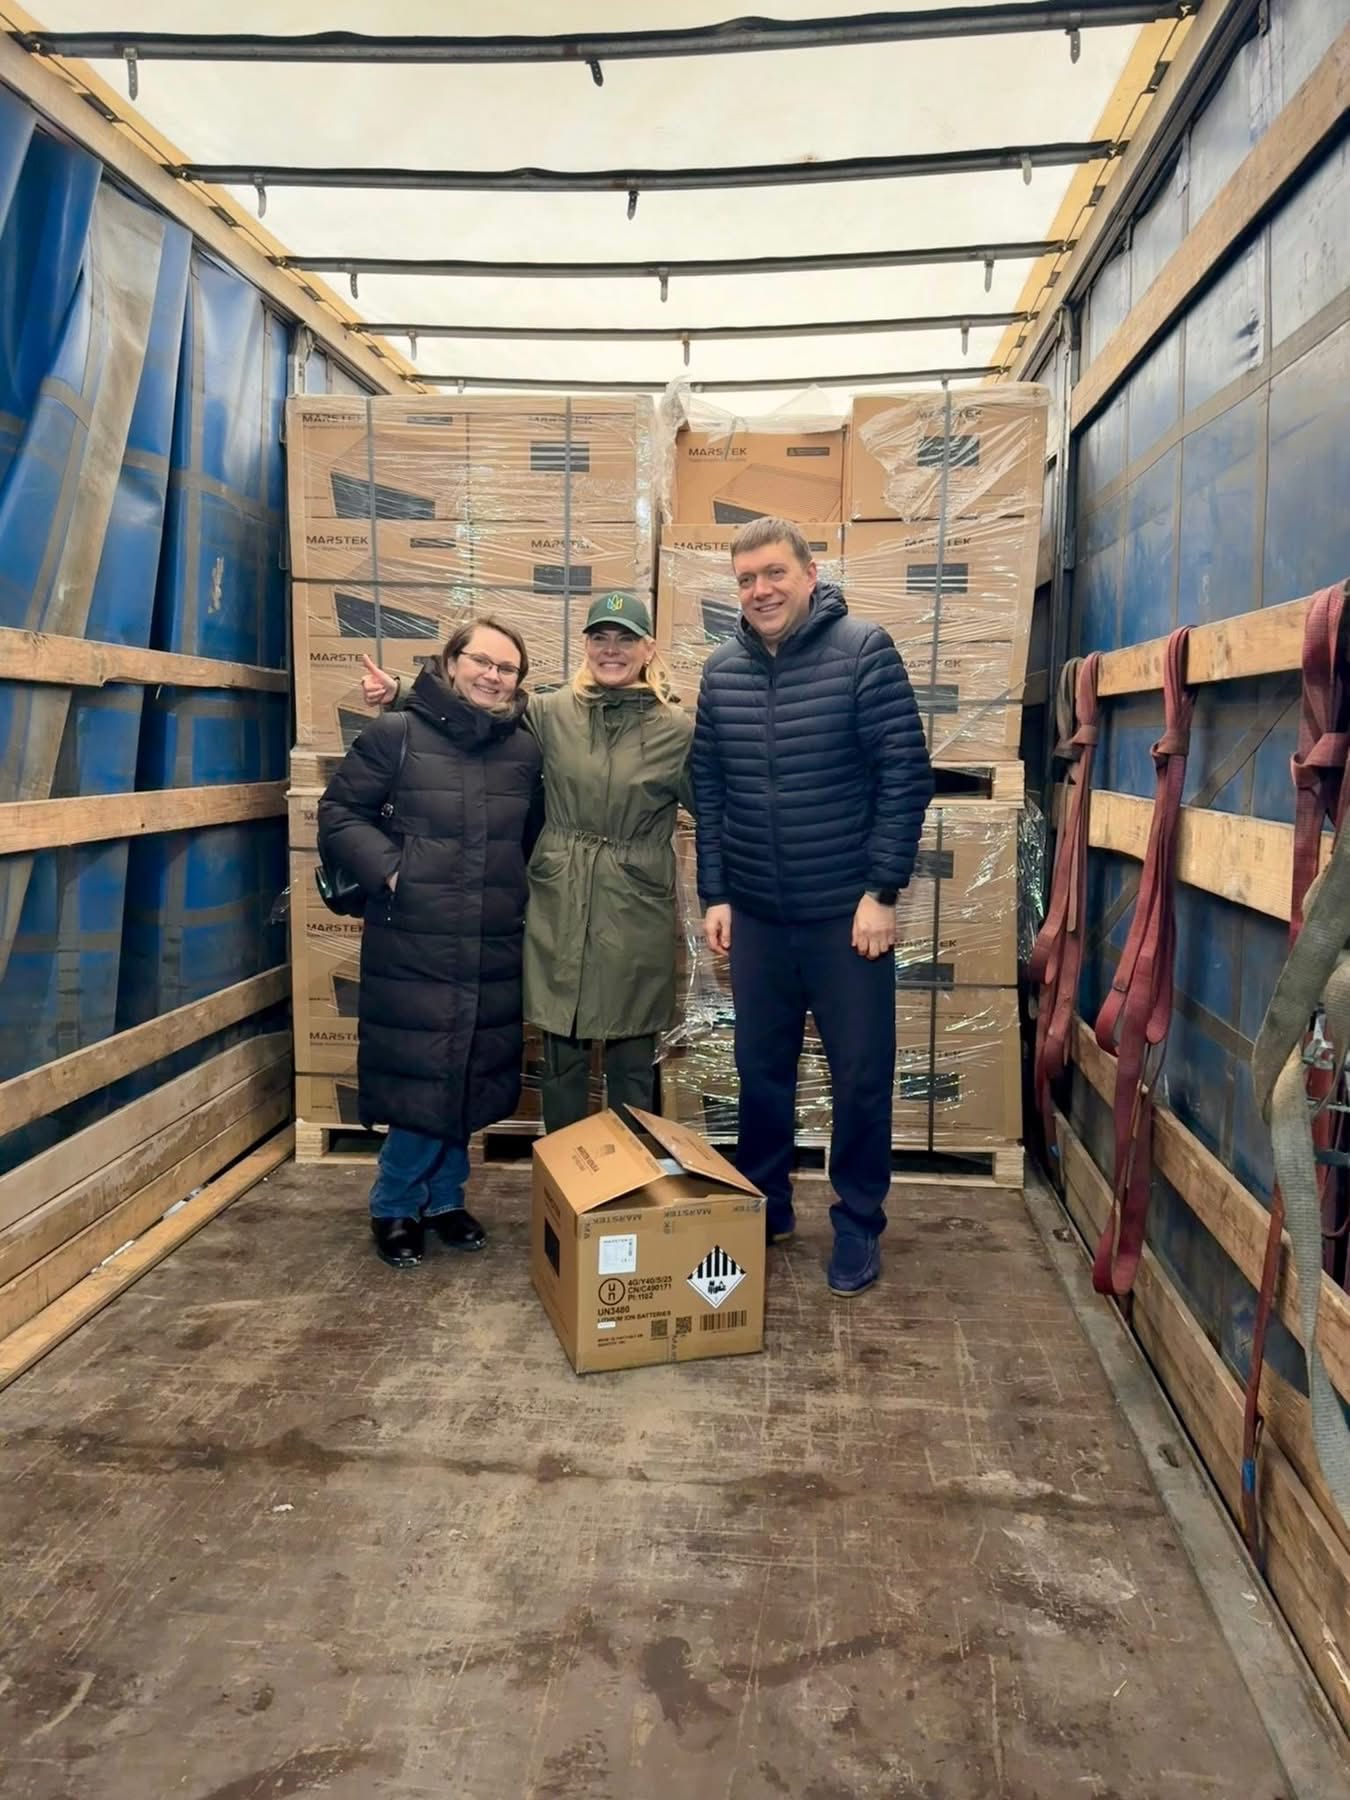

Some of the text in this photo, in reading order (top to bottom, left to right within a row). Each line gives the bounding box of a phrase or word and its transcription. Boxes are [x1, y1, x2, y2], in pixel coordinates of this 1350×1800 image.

[302, 414, 365, 423] MARST
[306, 535, 369, 545] MARSTEK
[904, 537, 972, 547] MATEK
[674, 542, 731, 551] MARSTE
[309, 653, 372, 662] MARSTE
[597, 1305, 630, 1317] UN3480
